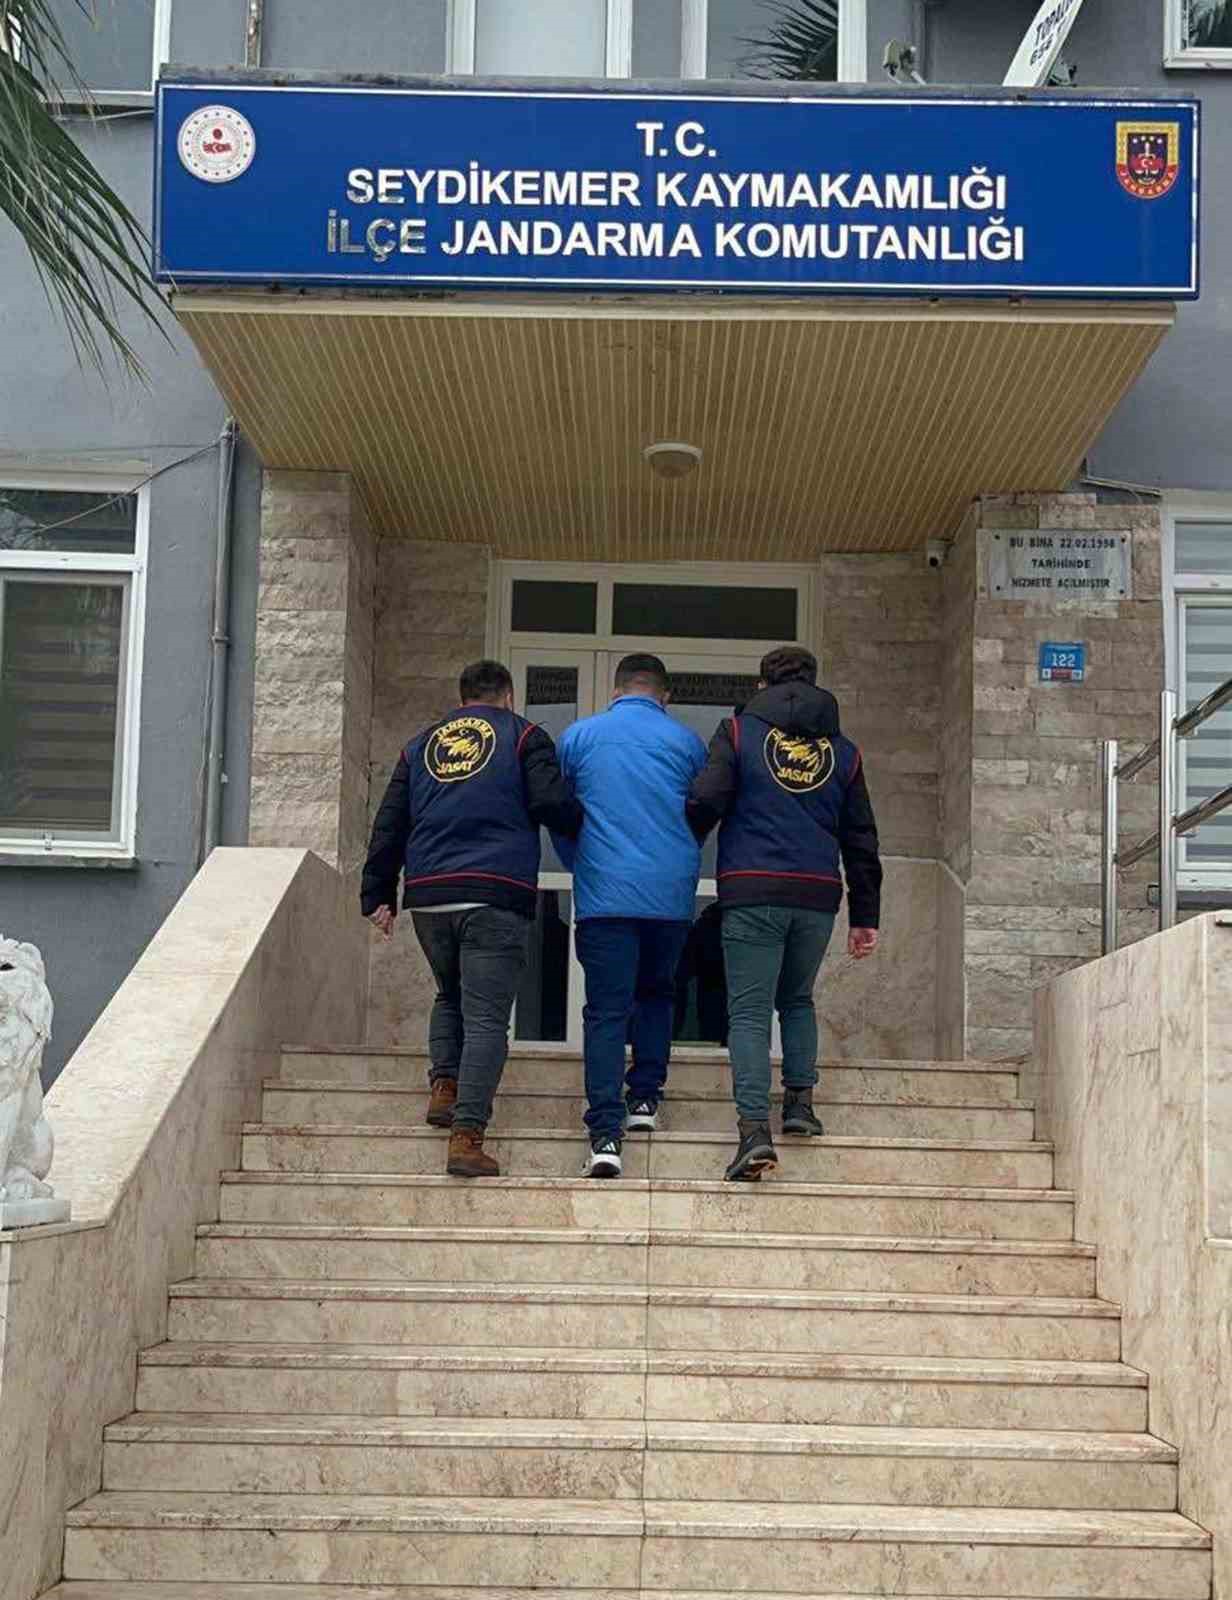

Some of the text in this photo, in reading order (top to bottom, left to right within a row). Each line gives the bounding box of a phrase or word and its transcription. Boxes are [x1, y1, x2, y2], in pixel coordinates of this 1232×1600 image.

[636, 121, 717, 158] T.C.
[346, 160, 1007, 211] SEYDİKEMER KAYMAKAMLIĞI
[326, 208, 1025, 263] İLÇE JANDARMA KOMUTANLIĞI
[1009, 537, 1024, 548] BU
[1031, 557, 1091, 569] TARİHİNDE
[1052, 653, 1075, 667] 122
[777, 767, 818, 784] JASAT
